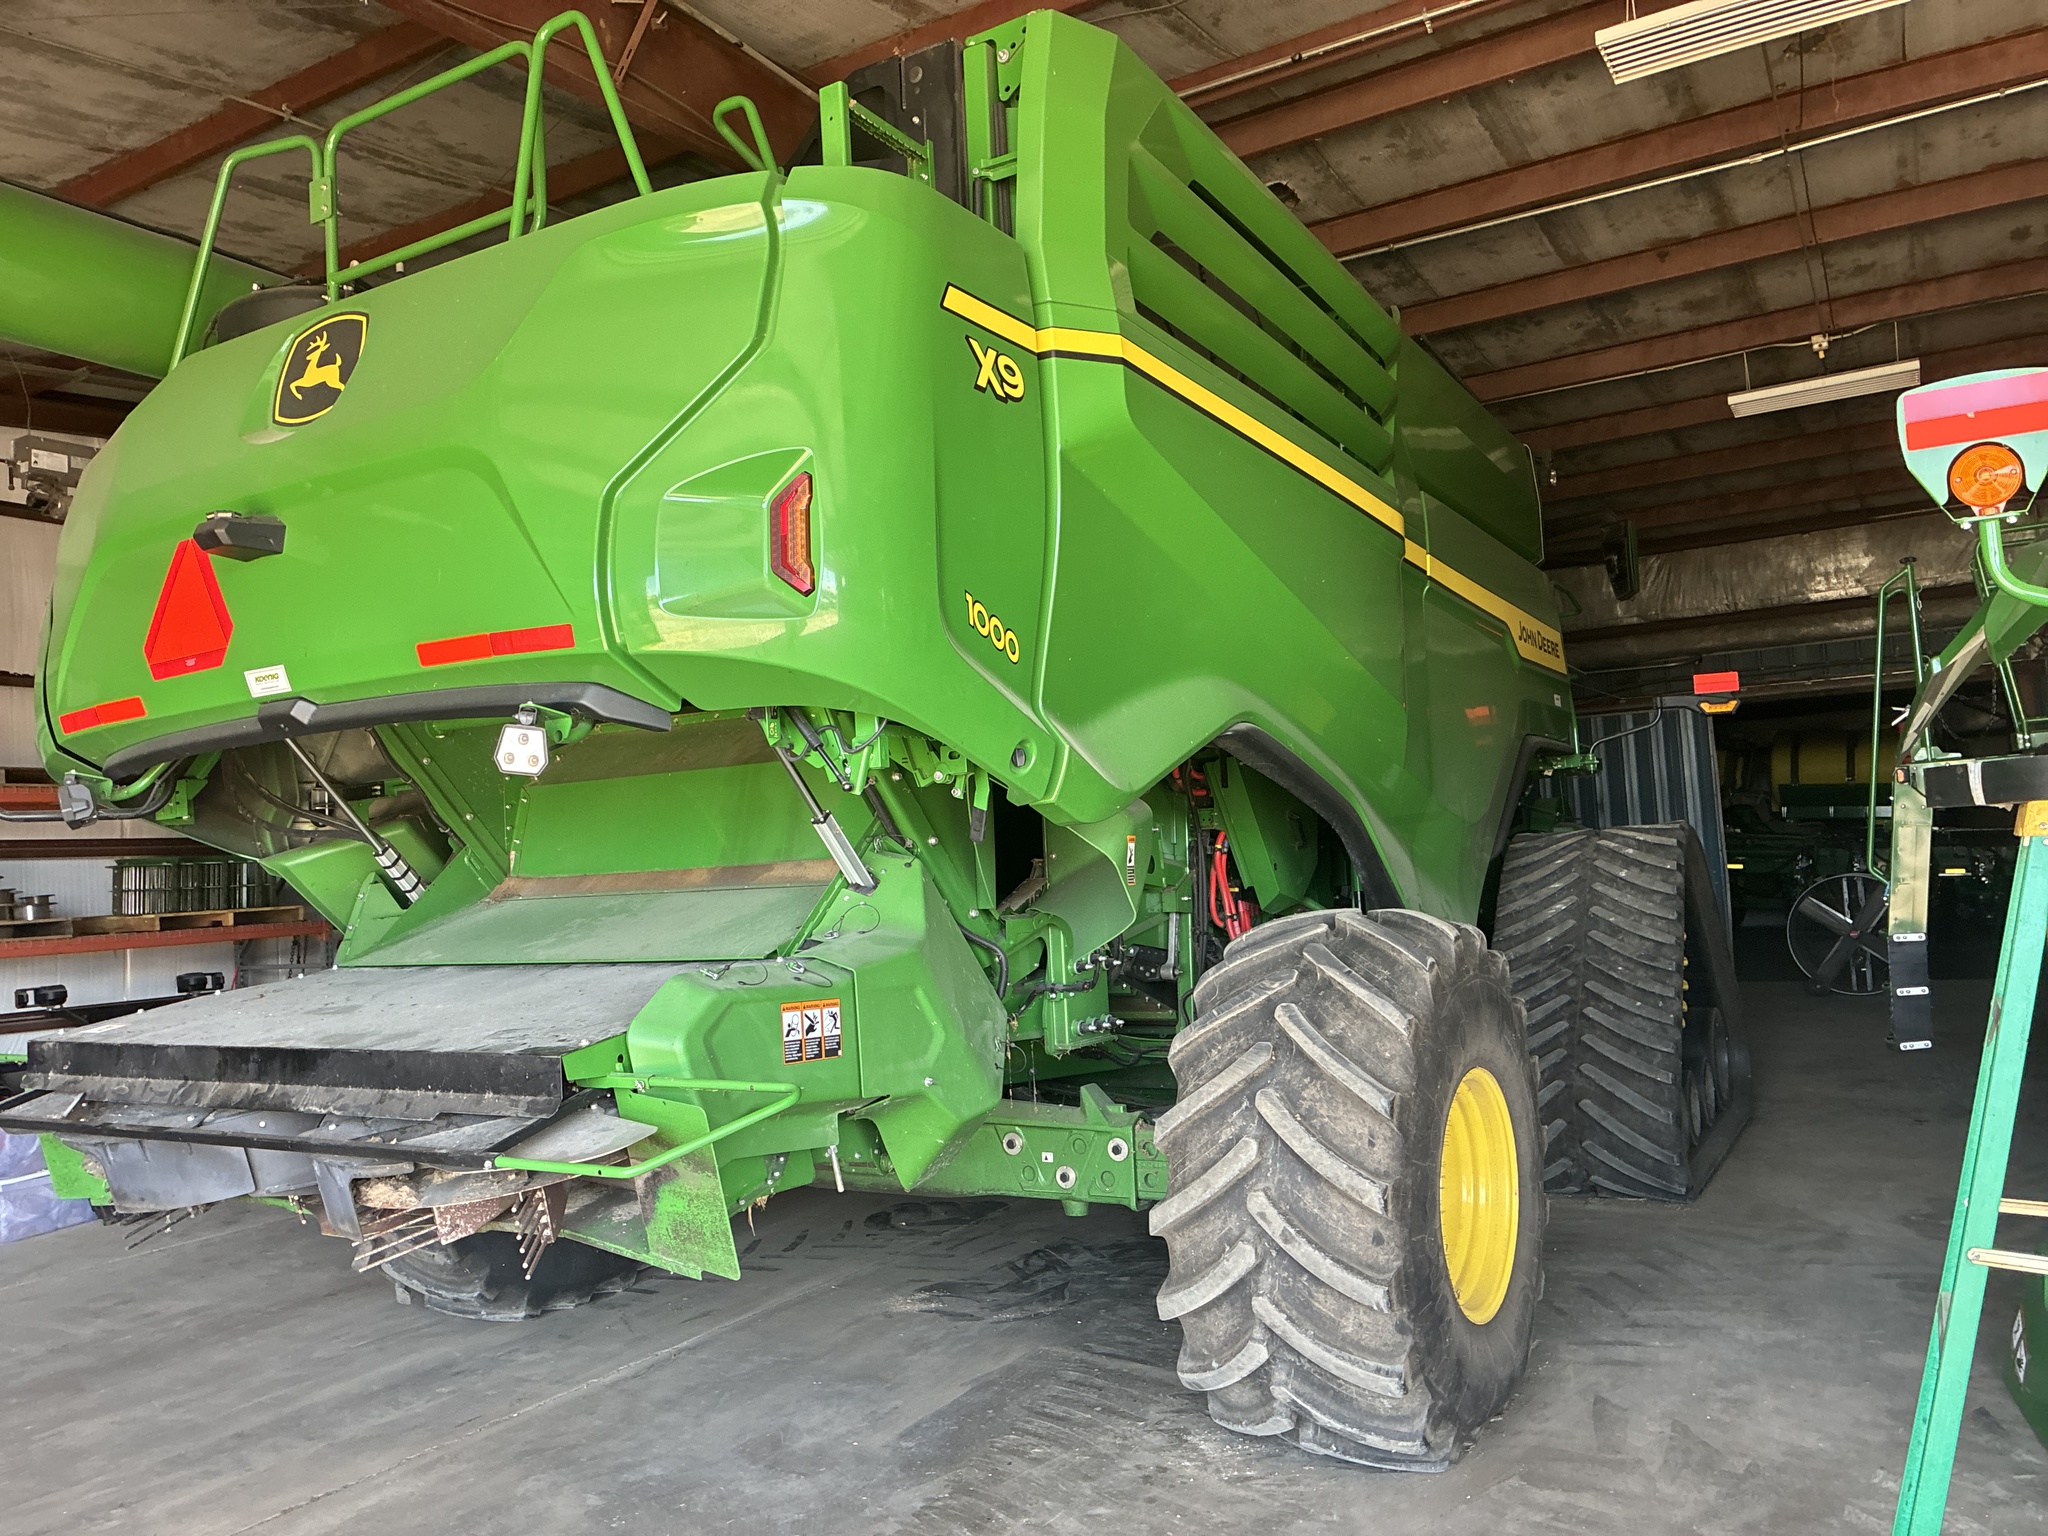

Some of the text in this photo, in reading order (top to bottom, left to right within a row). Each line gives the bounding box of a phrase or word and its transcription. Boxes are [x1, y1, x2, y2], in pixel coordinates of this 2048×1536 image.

[964, 334, 1026, 404] X9
[964, 589, 1020, 665] 1000
[1518, 620, 1560, 659] JOHN DEERE
